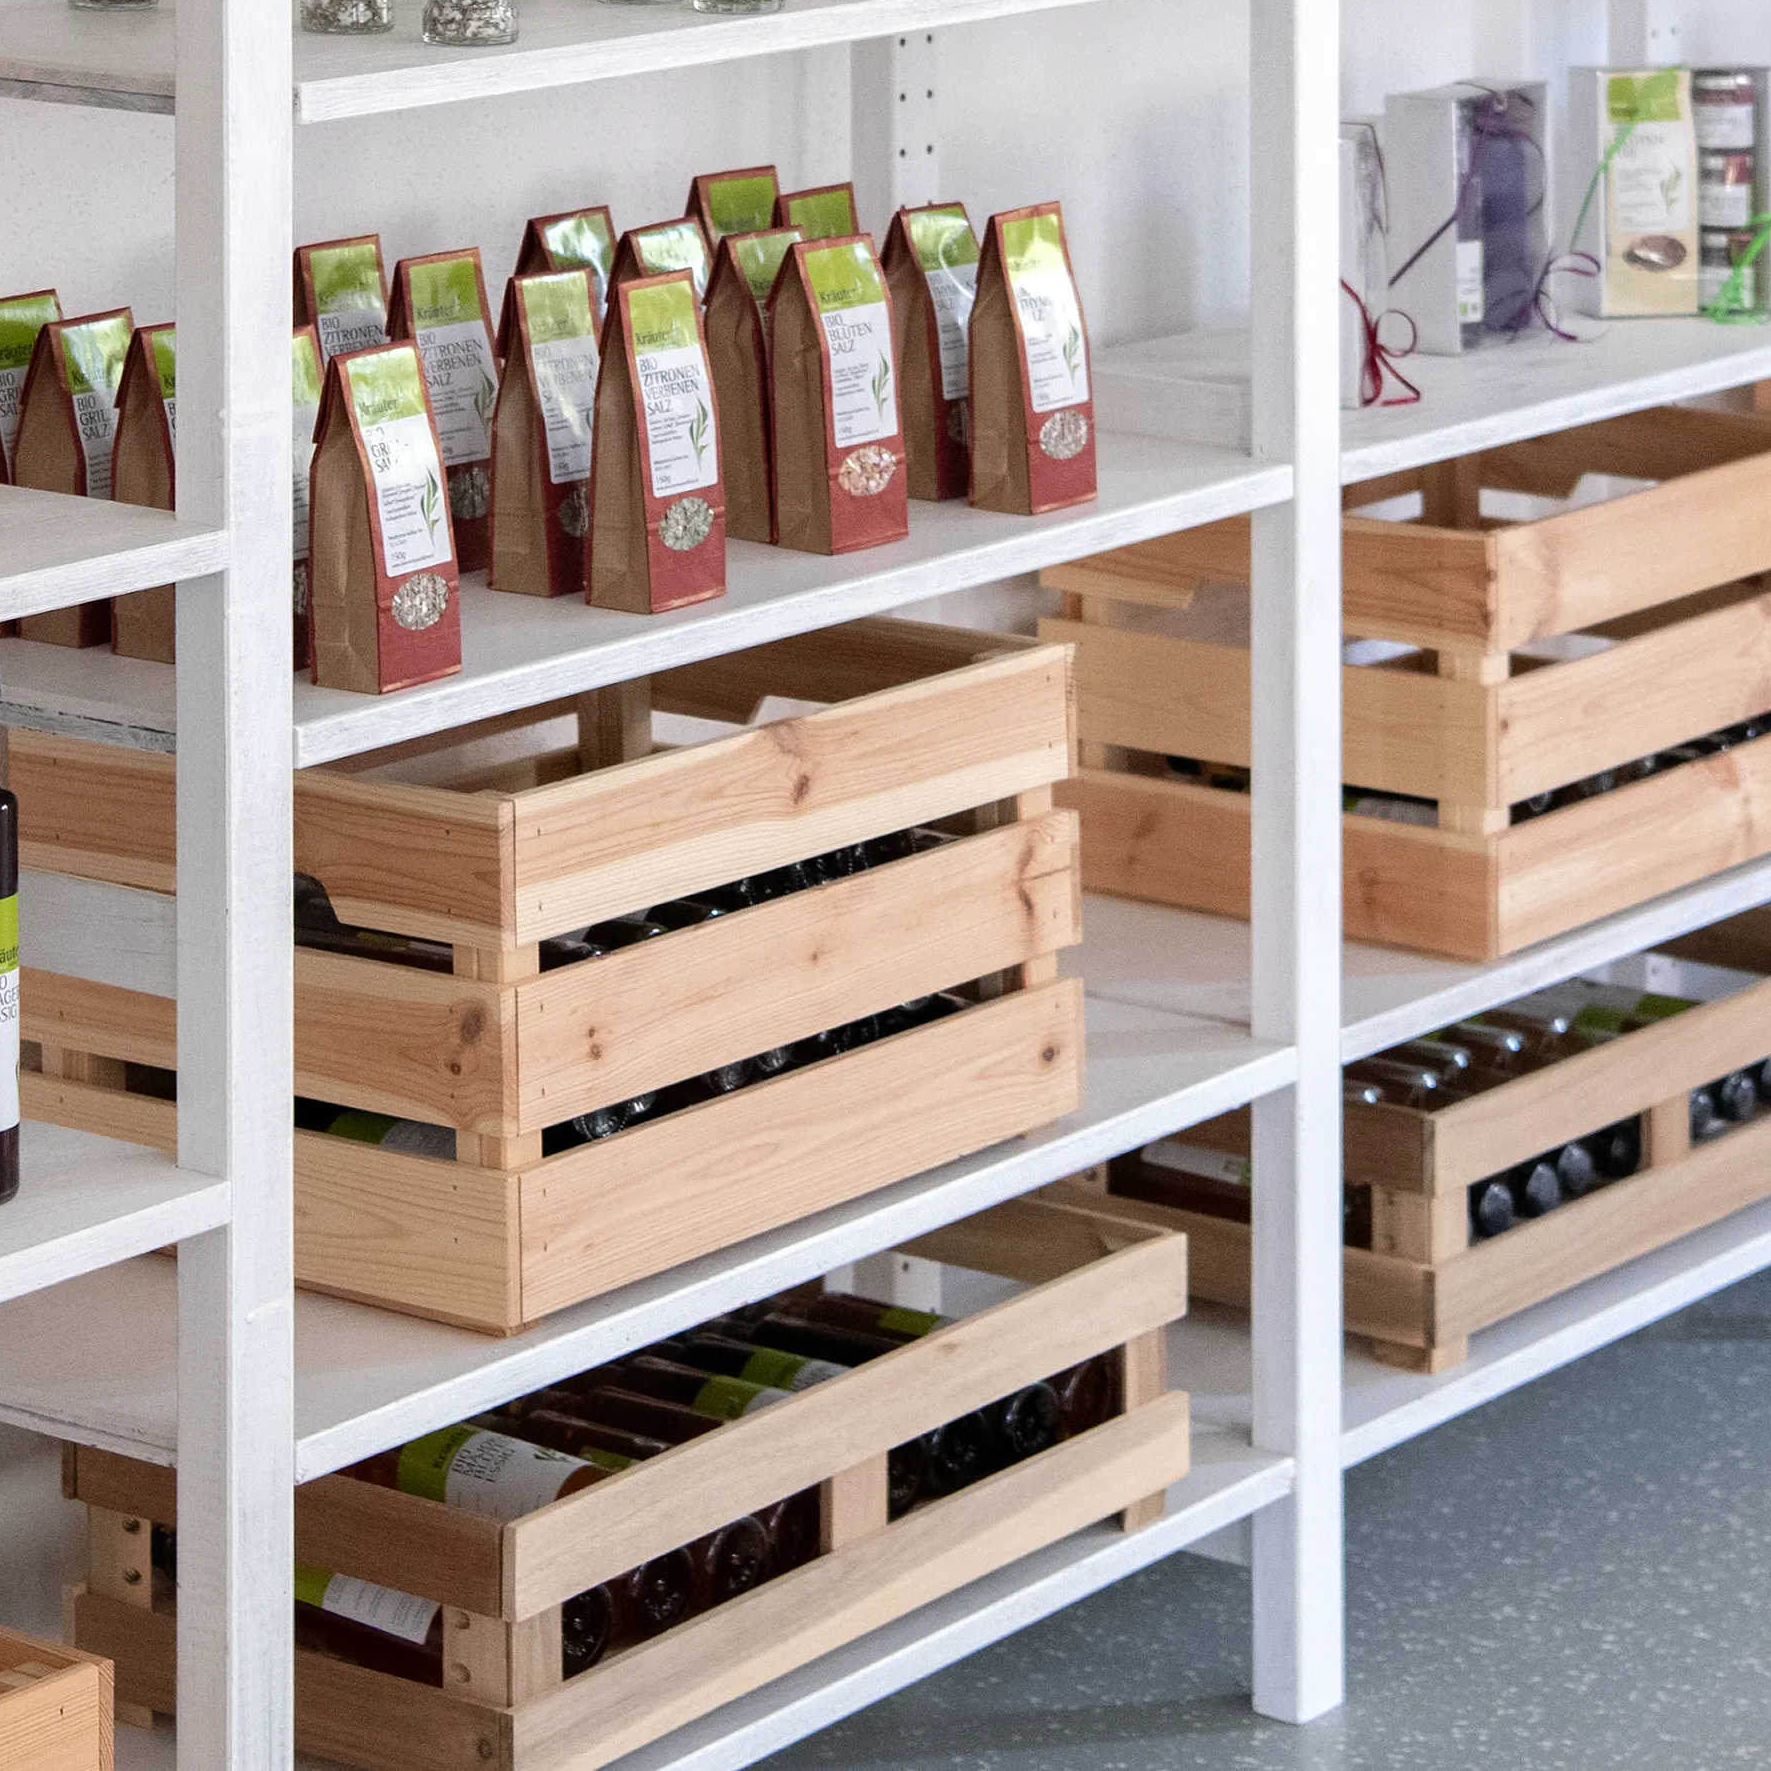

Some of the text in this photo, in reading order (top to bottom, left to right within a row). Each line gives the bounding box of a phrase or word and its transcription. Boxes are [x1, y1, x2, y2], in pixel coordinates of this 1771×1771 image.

[321, 317, 340, 330] BIO
[824, 313, 843, 327] BIO
[323, 324, 383, 345] ZITRONEN
[418, 332, 436, 347] BIO
[831, 338, 857, 357] SALZ
[638, 355, 658, 374] BIO
[426, 372, 453, 389] SALZ
[643, 363, 701, 387] ZITRONEN
[644, 379, 700, 402] VERBENEN
[77, 395, 97, 412] BIO
[646, 398, 674, 417] SALZ
